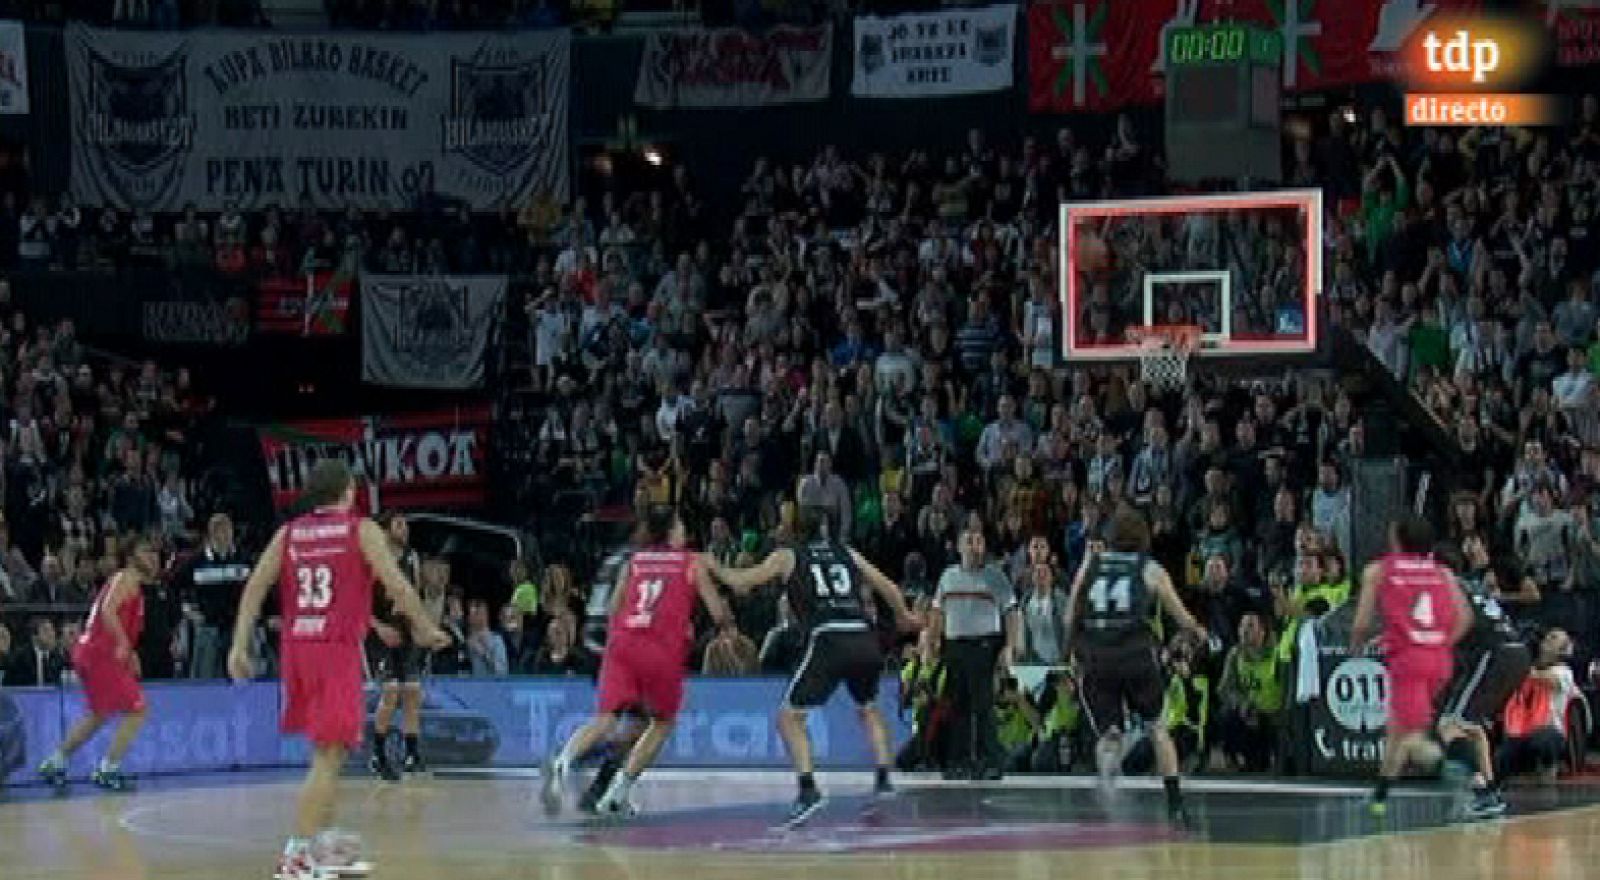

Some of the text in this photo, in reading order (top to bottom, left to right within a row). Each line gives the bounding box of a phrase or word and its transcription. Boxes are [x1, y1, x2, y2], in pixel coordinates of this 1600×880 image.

[1171, 29, 1245, 63] 00:00
[297, 566, 333, 608] 33
[810, 563, 850, 597] 13
[1410, 591, 1435, 627] 4
[1335, 674, 1386, 702] 011
